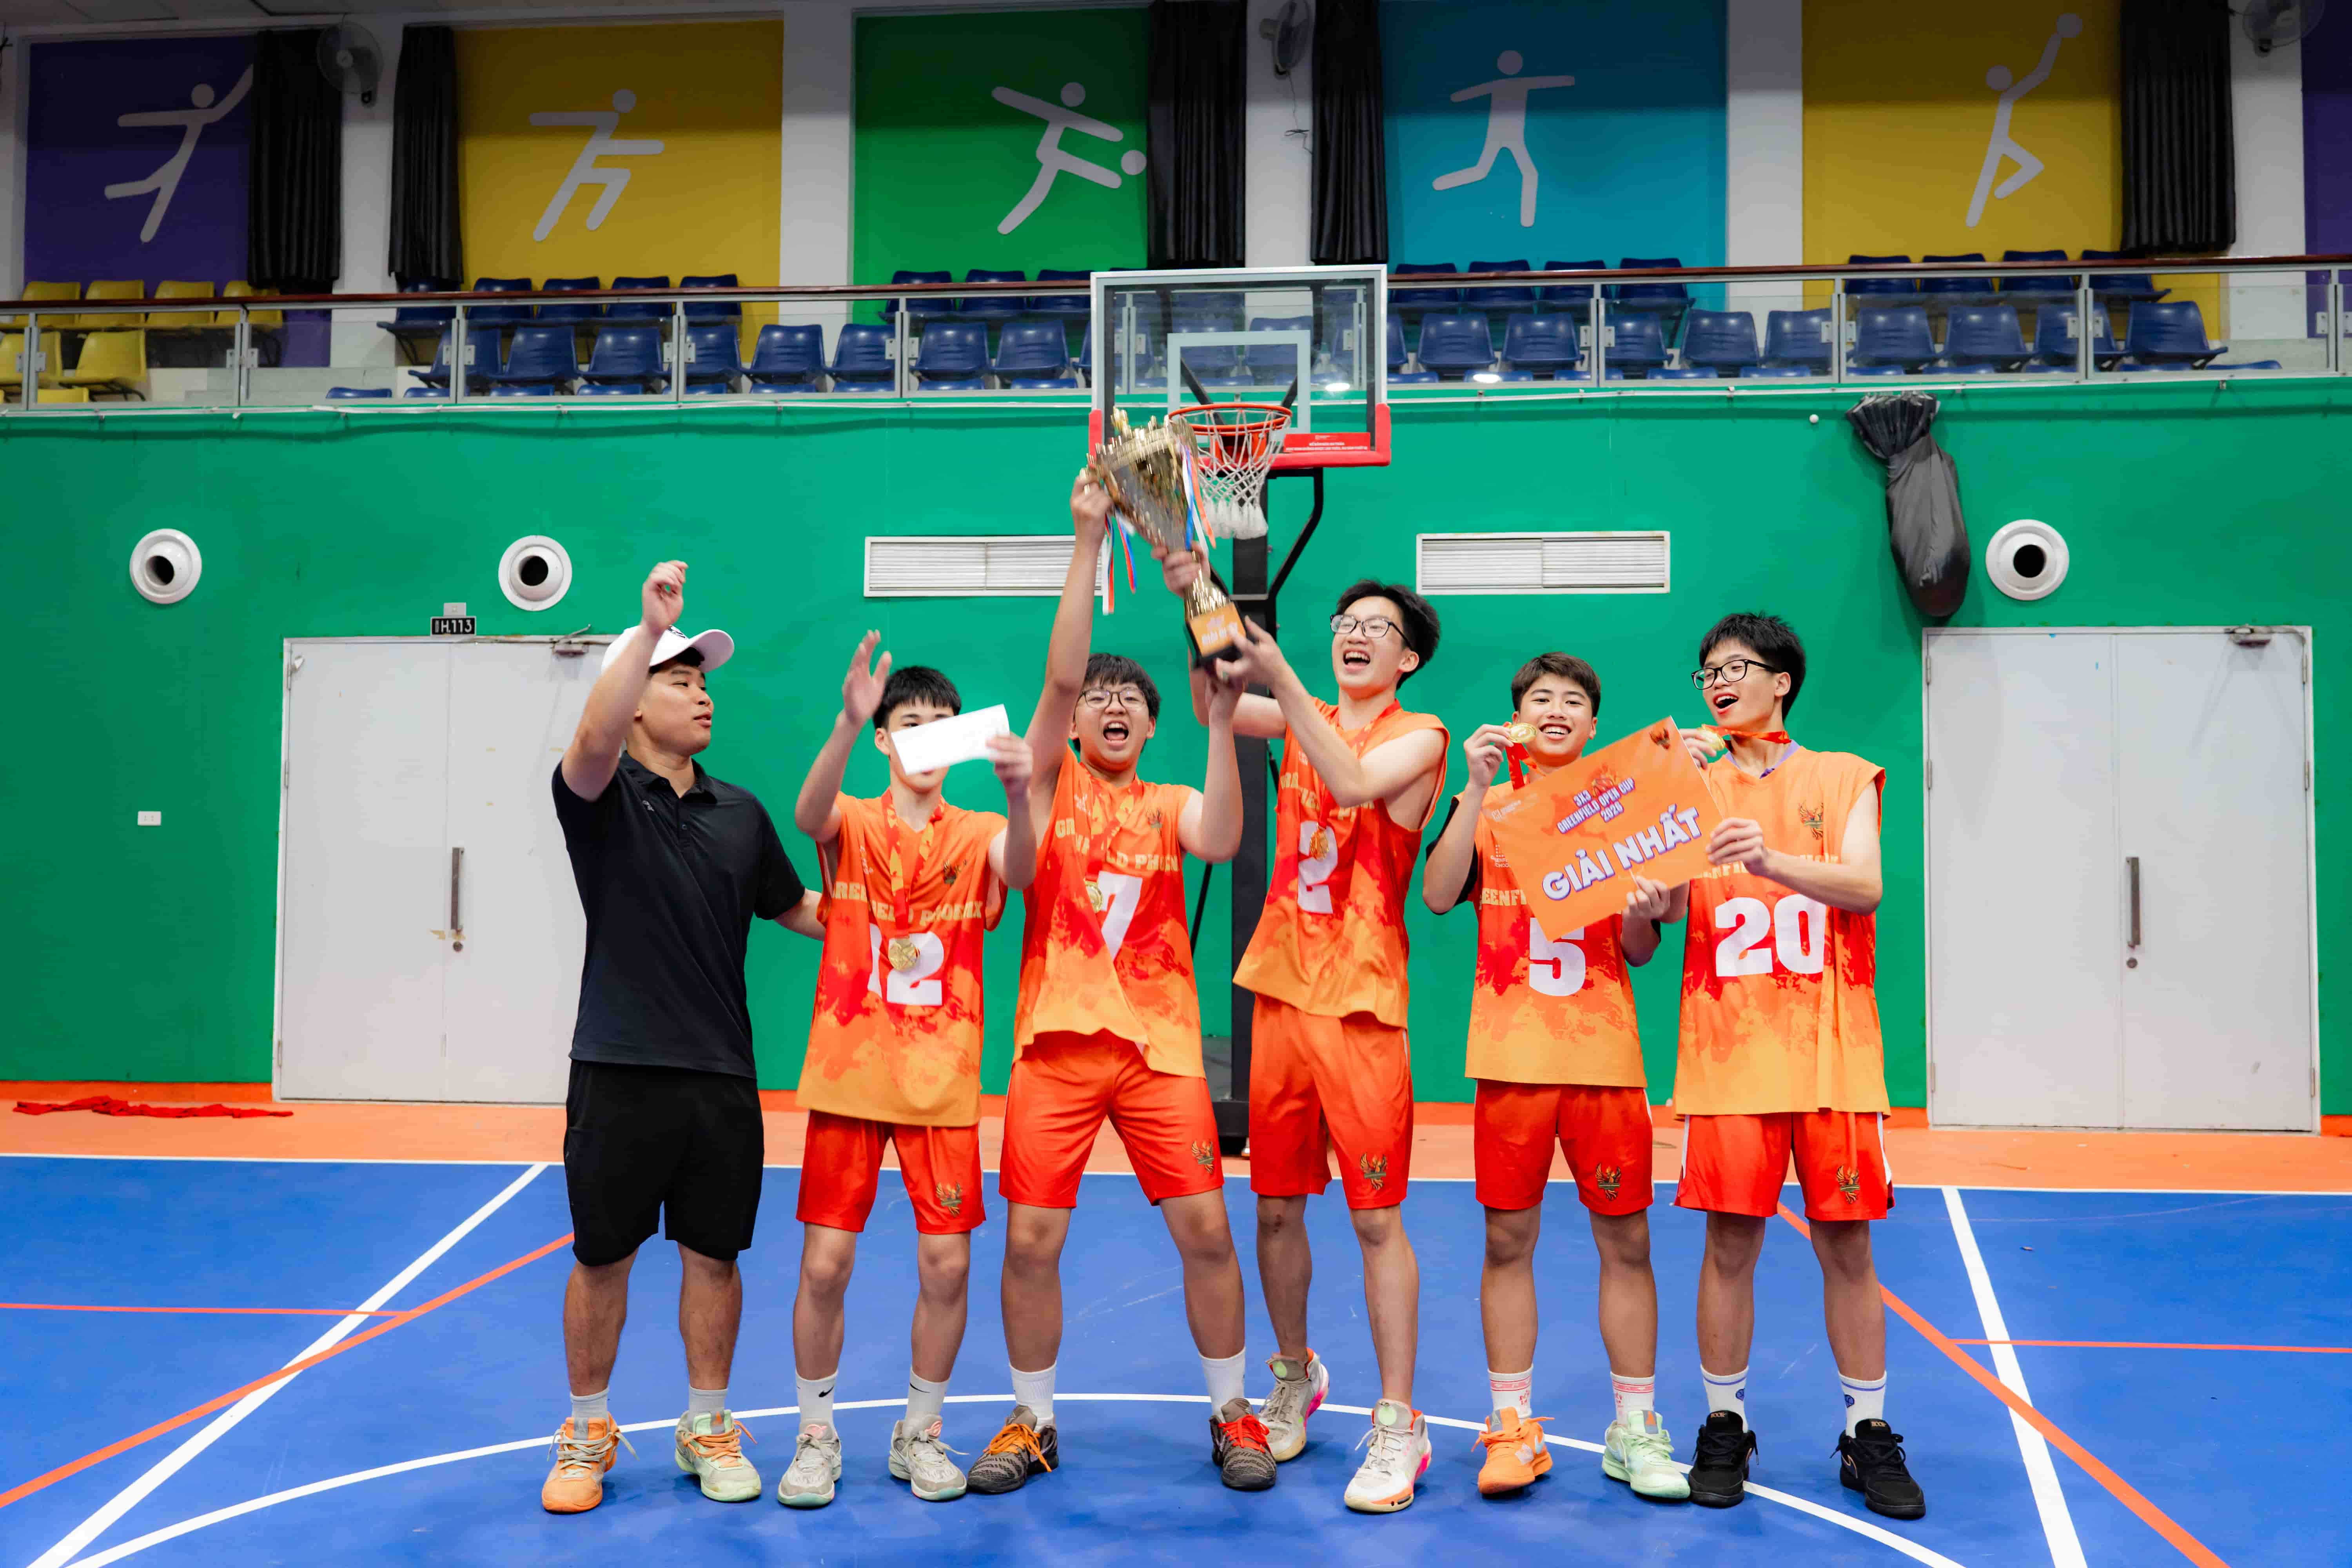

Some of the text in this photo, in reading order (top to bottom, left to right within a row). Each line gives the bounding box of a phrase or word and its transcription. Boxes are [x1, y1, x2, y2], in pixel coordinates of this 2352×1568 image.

[1557, 777, 1635, 834] GREENFIELD OPEN CUP
[1297, 820, 1338, 914] 2
[1542, 803, 1702, 901] GIẢI NHẤT
[1097, 870, 1143, 962] 7
[1529, 916, 1586, 996] 5
[1715, 893, 1827, 977] 20
